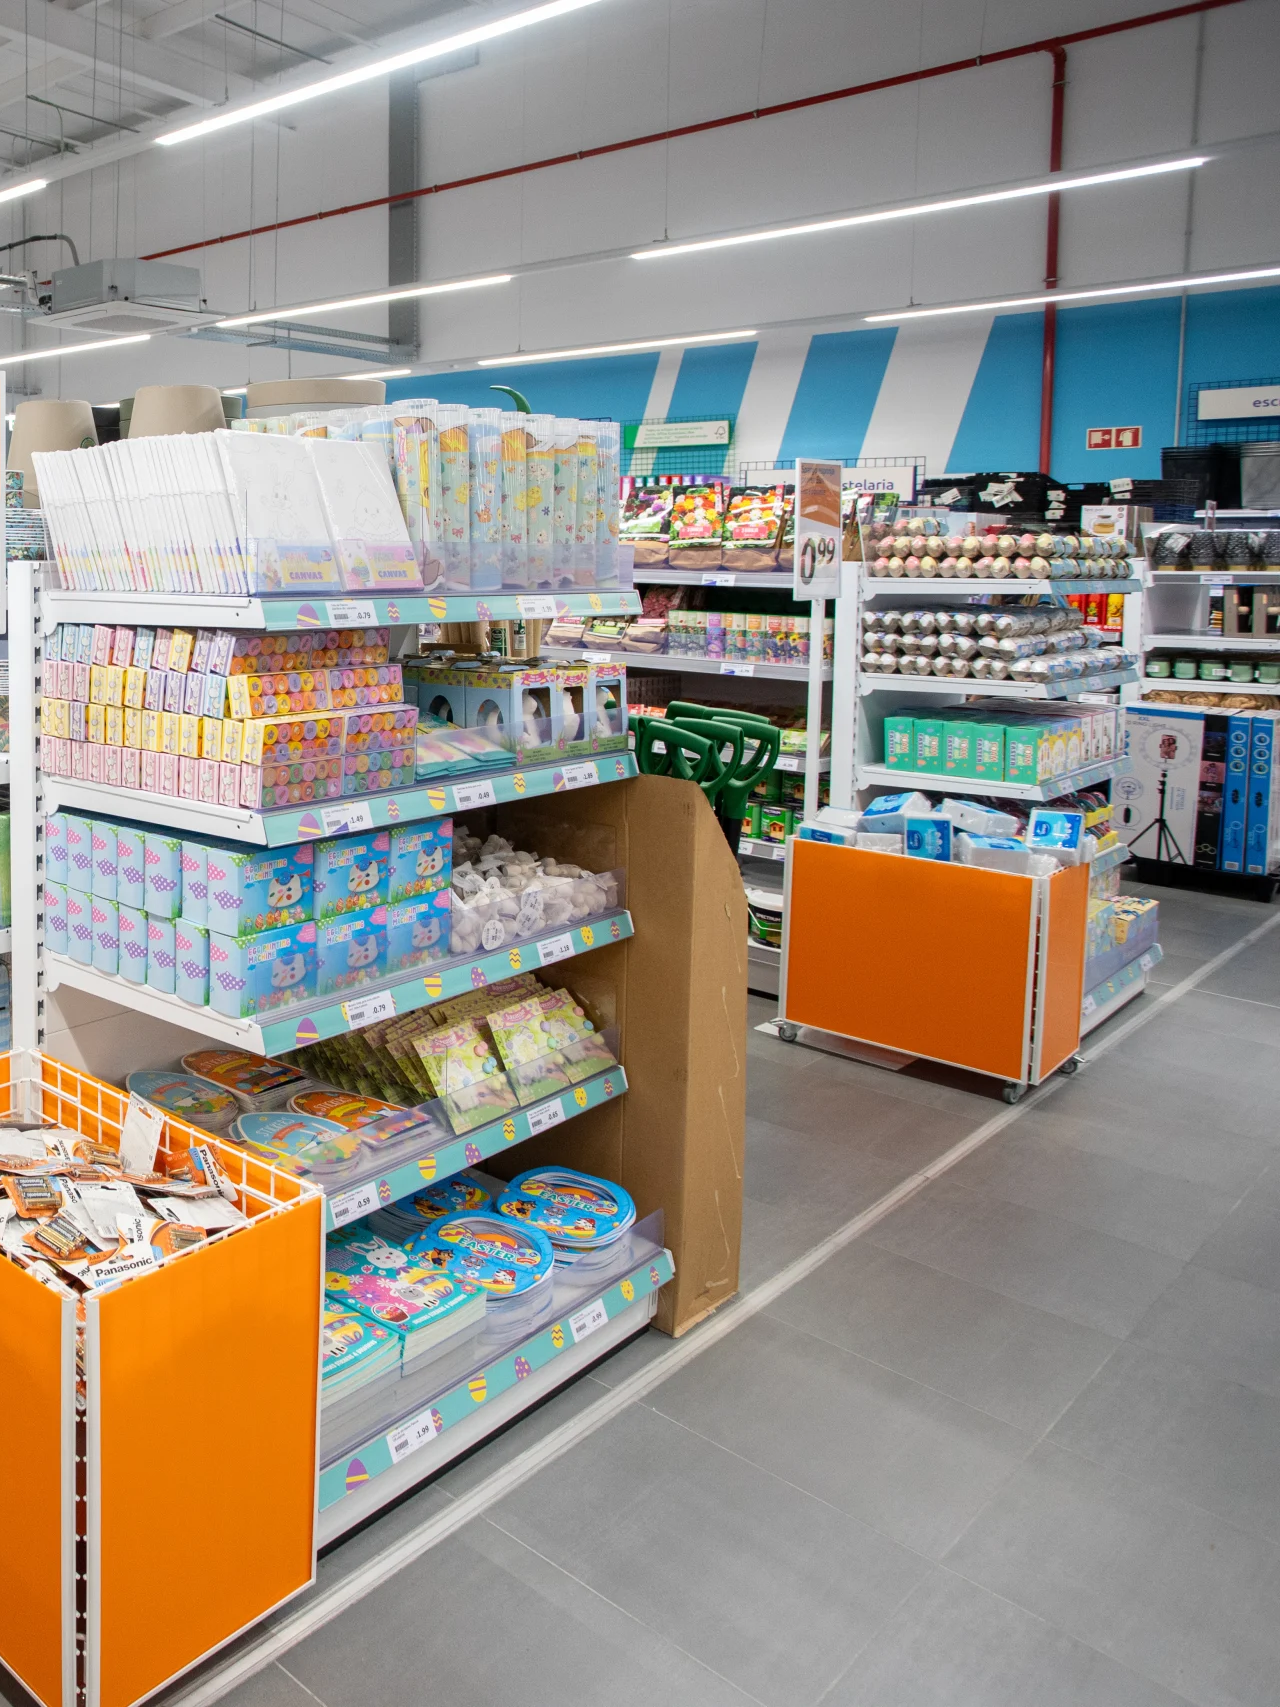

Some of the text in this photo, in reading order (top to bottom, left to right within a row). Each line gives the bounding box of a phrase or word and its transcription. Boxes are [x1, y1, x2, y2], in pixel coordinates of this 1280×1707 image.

[289, 572, 323, 580] CANVAS
[378, 570, 408, 579] CANVAS
[411, 832, 433, 843] PAINTING
[342, 846, 367, 857] PAINTING
[398, 842, 421, 852] MACHINE
[259, 859, 287, 870] PAINTING
[328, 857, 354, 868] MACHINE
[245, 871, 273, 882] MACHINE
[406, 904, 428, 915] PAINTING
[392, 914, 416, 926] MACHINE
[756, 913, 781, 922] SPECTRUM
[340, 921, 364, 933] PAINTING
[326, 933, 352, 945] MACHINE
[263, 939, 291, 951] PAINTING
[248, 951, 276, 964] MACHINE
[200, 1149, 225, 1197] Panasonic
[540, 1191, 594, 1210] EASTER
[458, 1237, 515, 1262] EASTER
[95, 1256, 153, 1277] Panasonic
